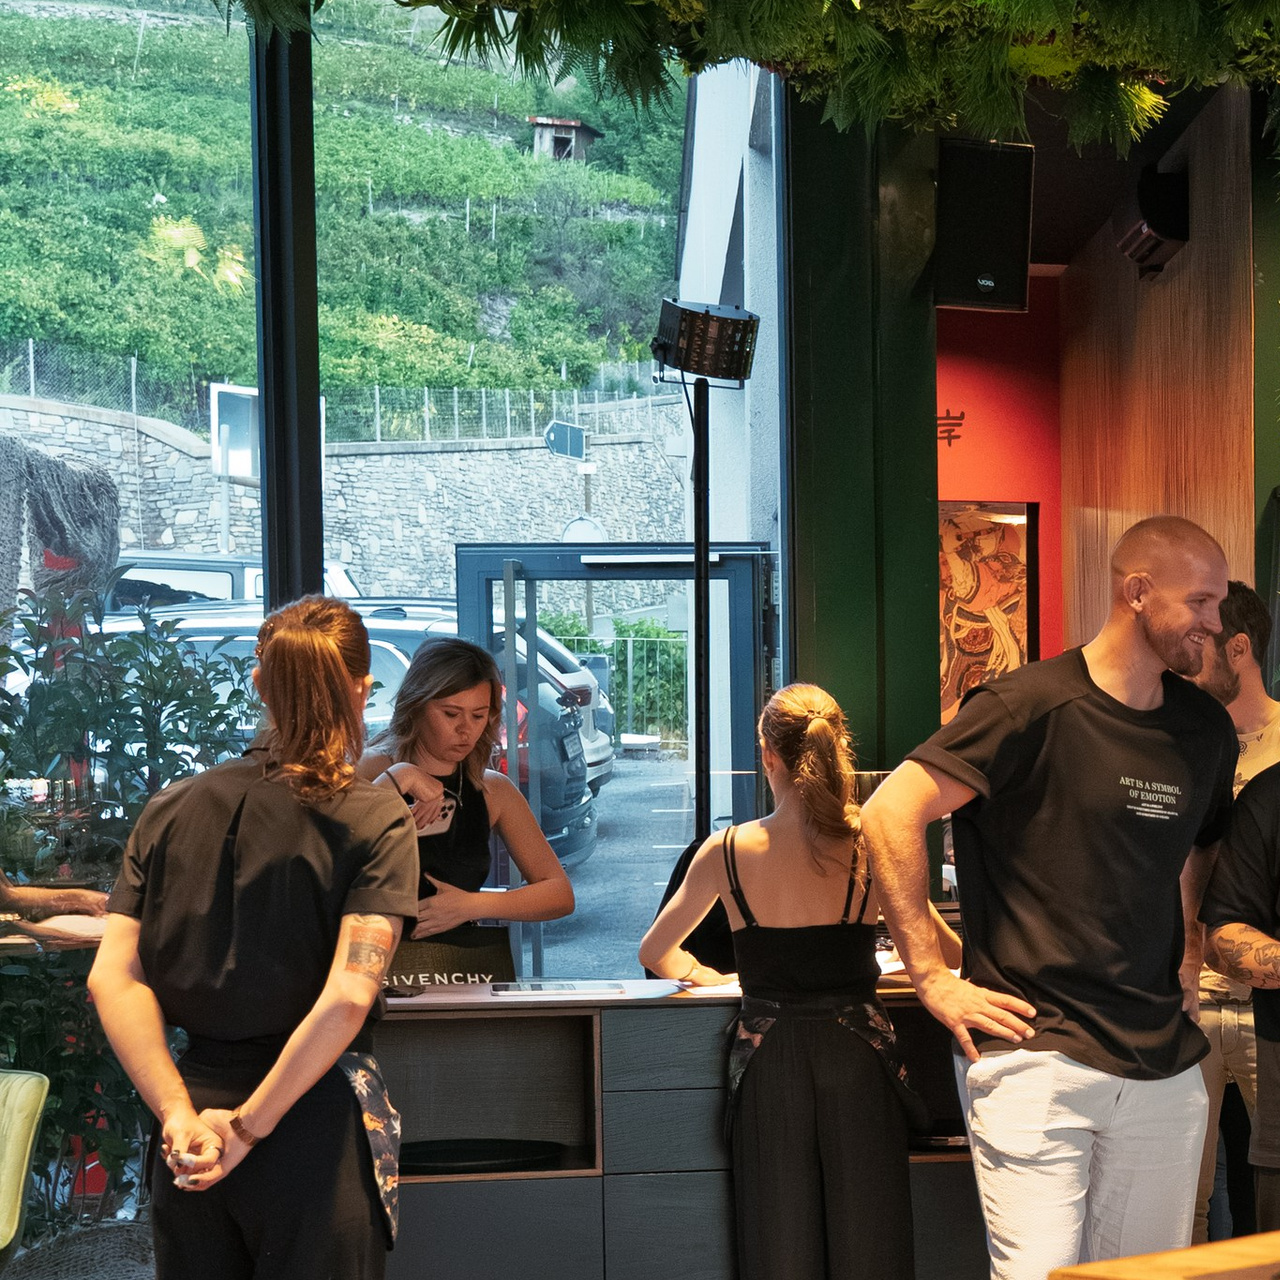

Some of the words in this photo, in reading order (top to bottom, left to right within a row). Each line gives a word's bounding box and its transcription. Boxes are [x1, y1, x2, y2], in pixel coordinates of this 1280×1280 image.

[1119, 776, 1135, 787] ART
[1135, 780, 1144, 789] IS
[1144, 782, 1151, 790] A
[1151, 782, 1182, 795] SYMBOL
[1129, 789, 1140, 799] OF
[1140, 791, 1177, 805] EMOTION
